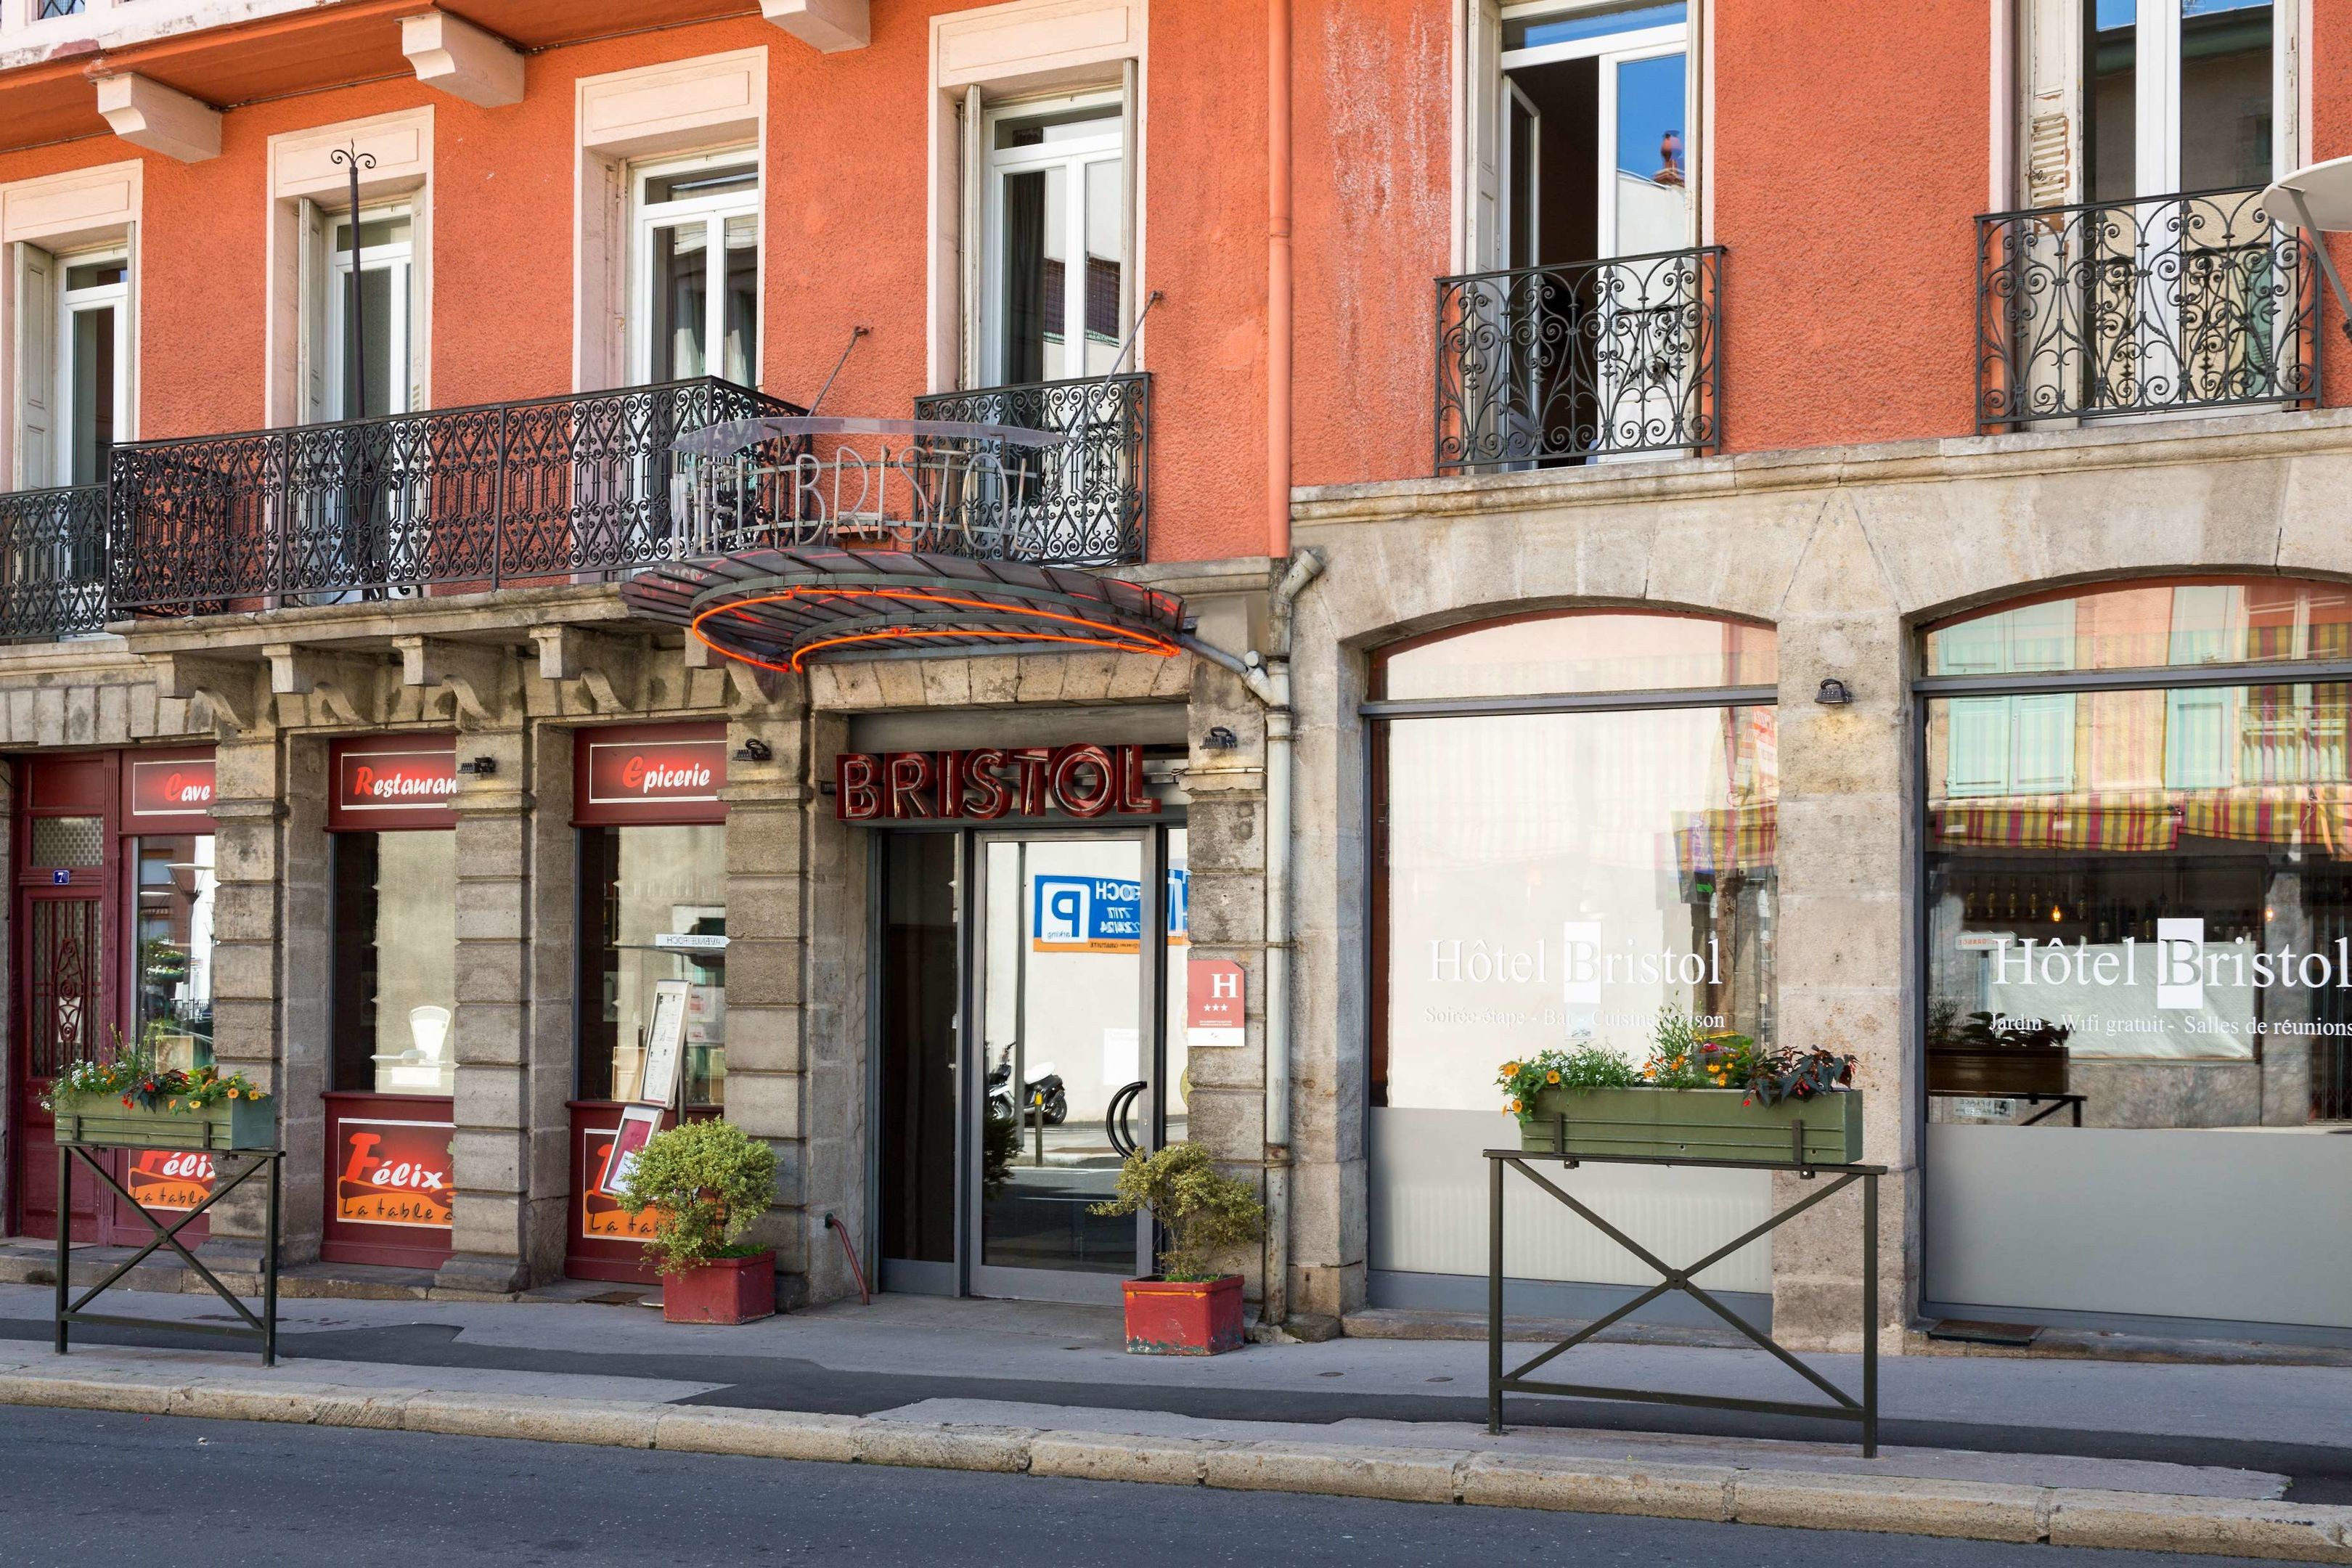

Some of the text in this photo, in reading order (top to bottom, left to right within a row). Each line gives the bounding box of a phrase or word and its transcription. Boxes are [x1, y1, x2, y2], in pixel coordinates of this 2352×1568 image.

[795, 444, 1043, 555] BRISTOL
[164, 772, 211, 801] Cave
[354, 766, 458, 798] Restauran
[622, 756, 711, 793] Epicerie
[836, 743, 1162, 821] BRISTOL
[57, 872, 65, 883] 7
[1427, 938, 1723, 985] Hôtel Bristol
[1992, 936, 2352, 988] Hôtel Bristol
[1211, 973, 1238, 998] H
[1592, 1010, 1656, 1028] Cuisine
[1988, 1013, 2042, 1031] Jardin
[2063, 1013, 2100, 1032] Wifi
[2184, 1016, 2239, 1034] Salles
[2245, 1016, 2267, 1035] de
[2273, 1017, 2352, 1037] réunions
[345, 1132, 443, 1188] Félix
[343, 1198, 369, 1215] La
[377, 1198, 433, 1220] table
[590, 1212, 618, 1231] La
